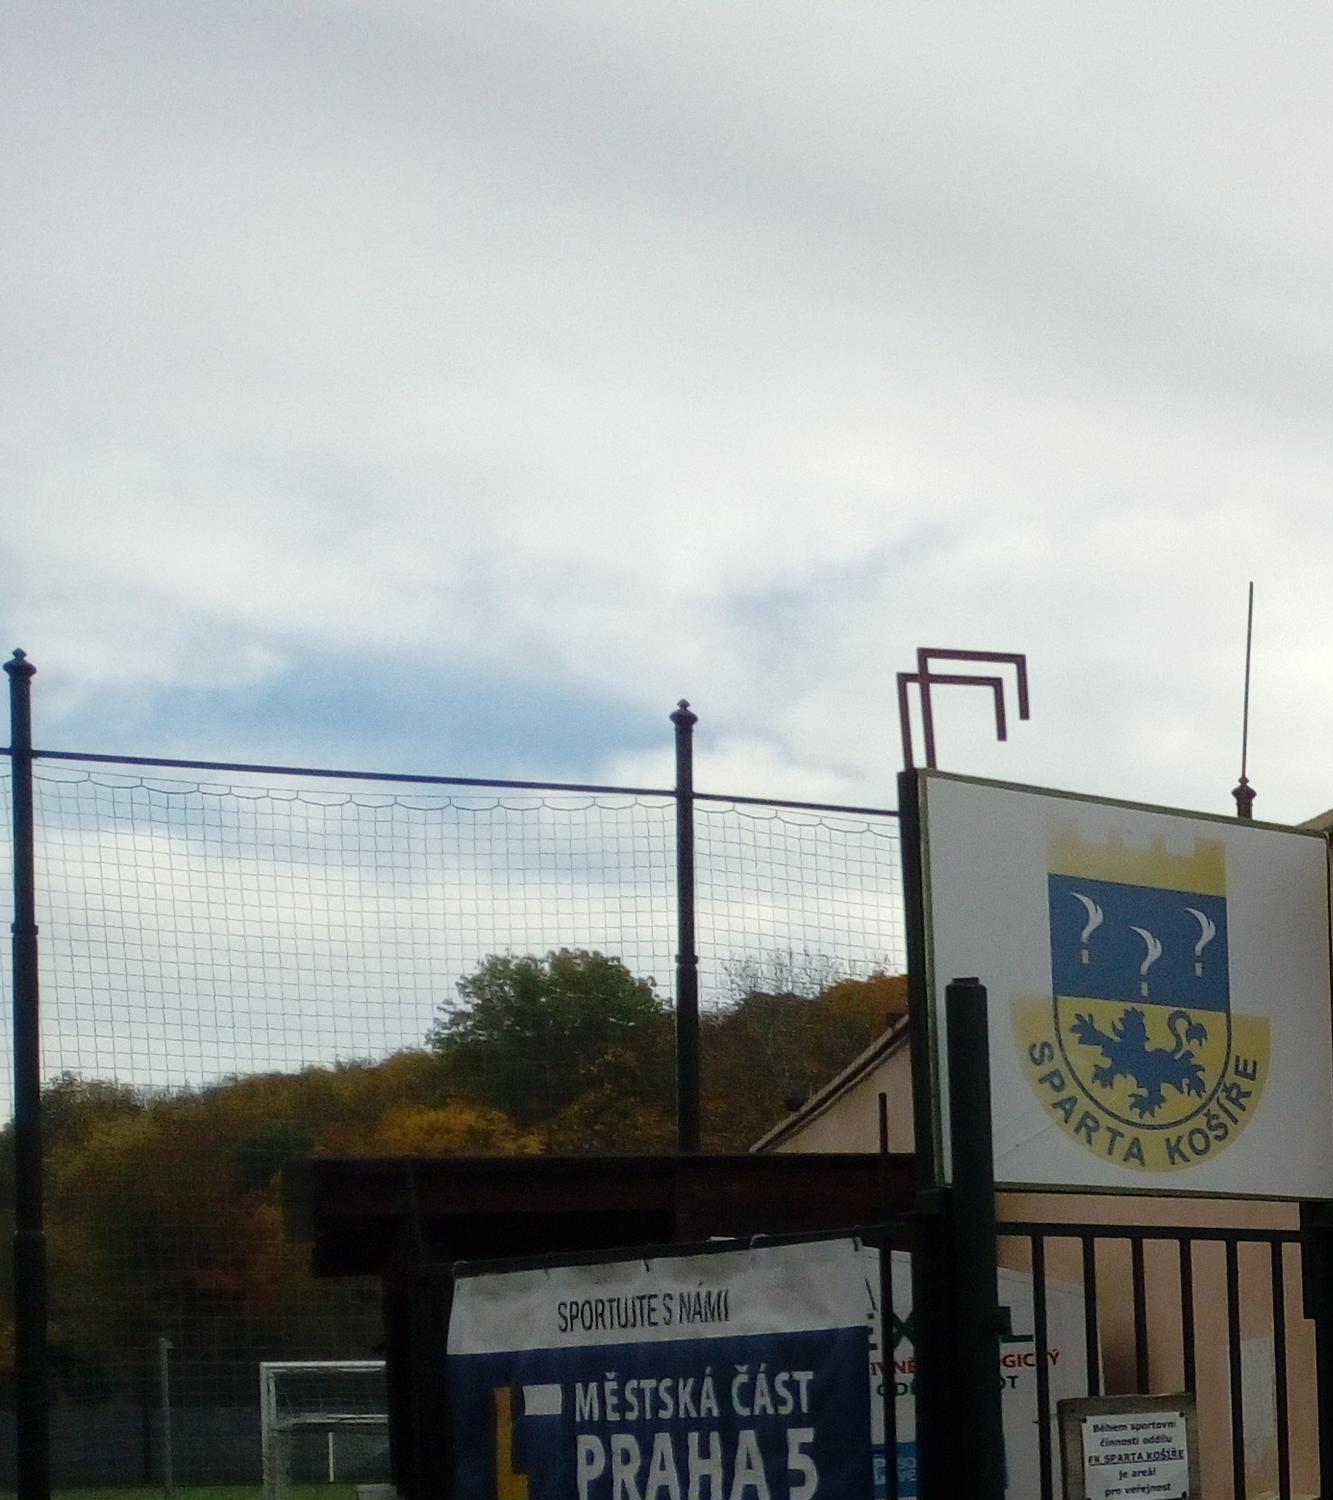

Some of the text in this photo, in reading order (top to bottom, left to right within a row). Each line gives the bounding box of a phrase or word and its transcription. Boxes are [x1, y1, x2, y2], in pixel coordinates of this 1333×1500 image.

[1028, 1040, 1257, 1166] SPARTA KOŠÍŘE
[558, 1281, 729, 1332] SPORTUJTE S NÁMI
[574, 1363, 815, 1422] MĚSTSKÁ ČÁST
[1105, 1452, 1143, 1464] SPARTA
[1119, 1470, 1128, 1480] je
[1105, 1488, 1122, 1497] pro
